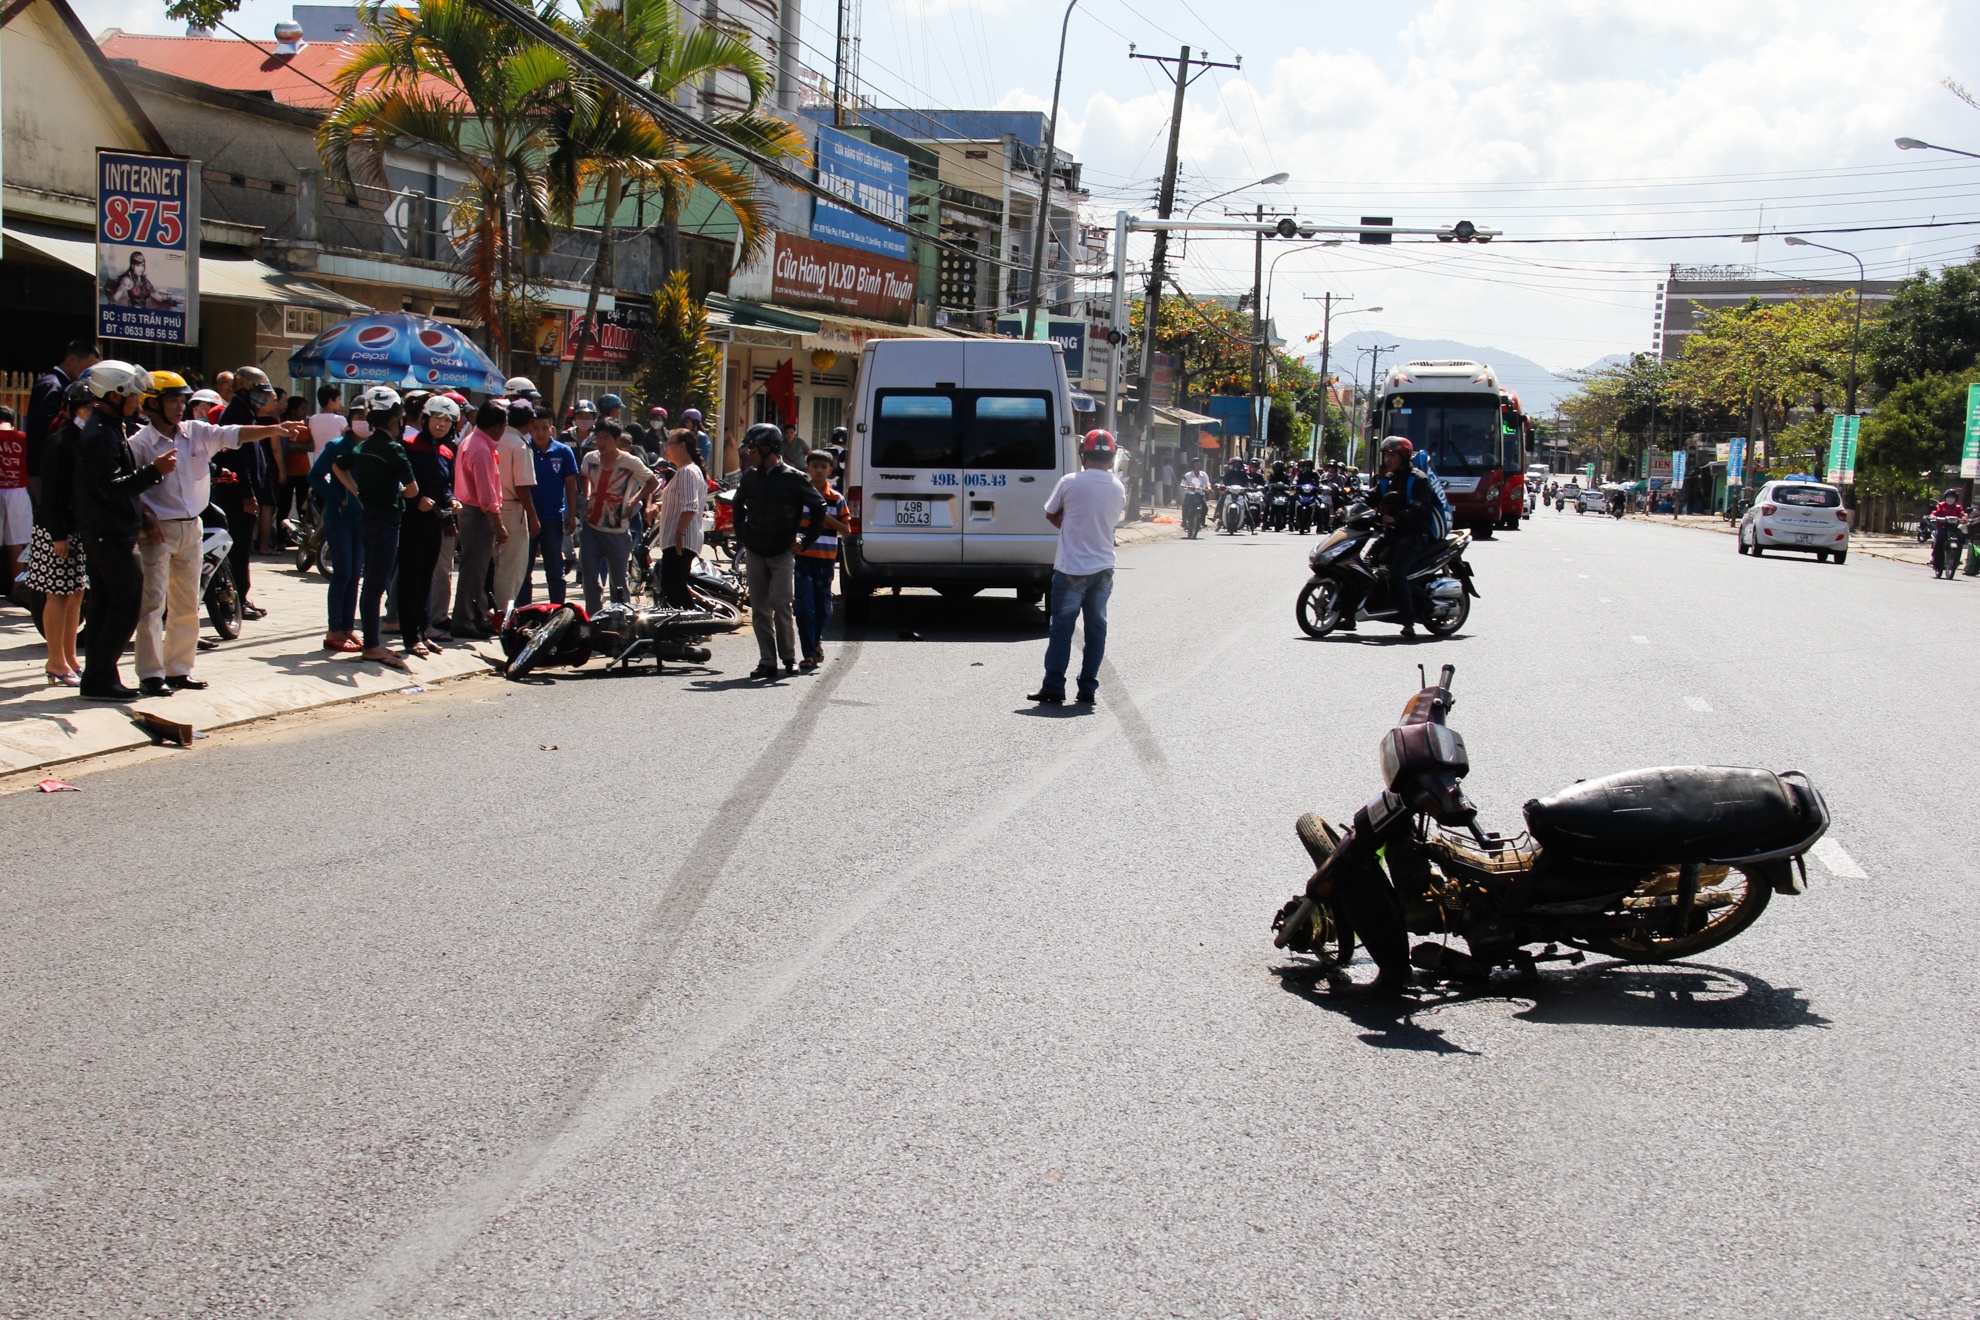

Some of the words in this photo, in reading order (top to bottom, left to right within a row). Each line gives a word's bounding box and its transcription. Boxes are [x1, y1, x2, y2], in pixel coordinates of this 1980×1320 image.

[105, 163, 182, 196] INTERNET
[104, 195, 182, 245] 875
[776, 248, 797, 280] Cửa
[798, 255, 826, 293] Hàng
[828, 261, 856, 290] VLXD
[857, 267, 882, 296] Bình
[883, 272, 913, 306] Thuận
[122, 312, 137, 323] 875
[163, 315, 182, 328] PHÚ
[124, 325, 144, 337] 0633
[145, 328, 155, 338] 86
[156, 329, 166, 339] 56
[168, 330, 178, 340] 55
[351, 352, 389, 361] pepsi
[430, 357, 463, 367] pepsi
[361, 367, 390, 377] pepsi
[442, 373, 468, 383] pepsi
[879, 473, 916, 481] TRANSIT
[964, 474, 1006, 487] 005.43
[904, 501, 923, 512] 49B
[897, 513, 930, 525] 005.43
